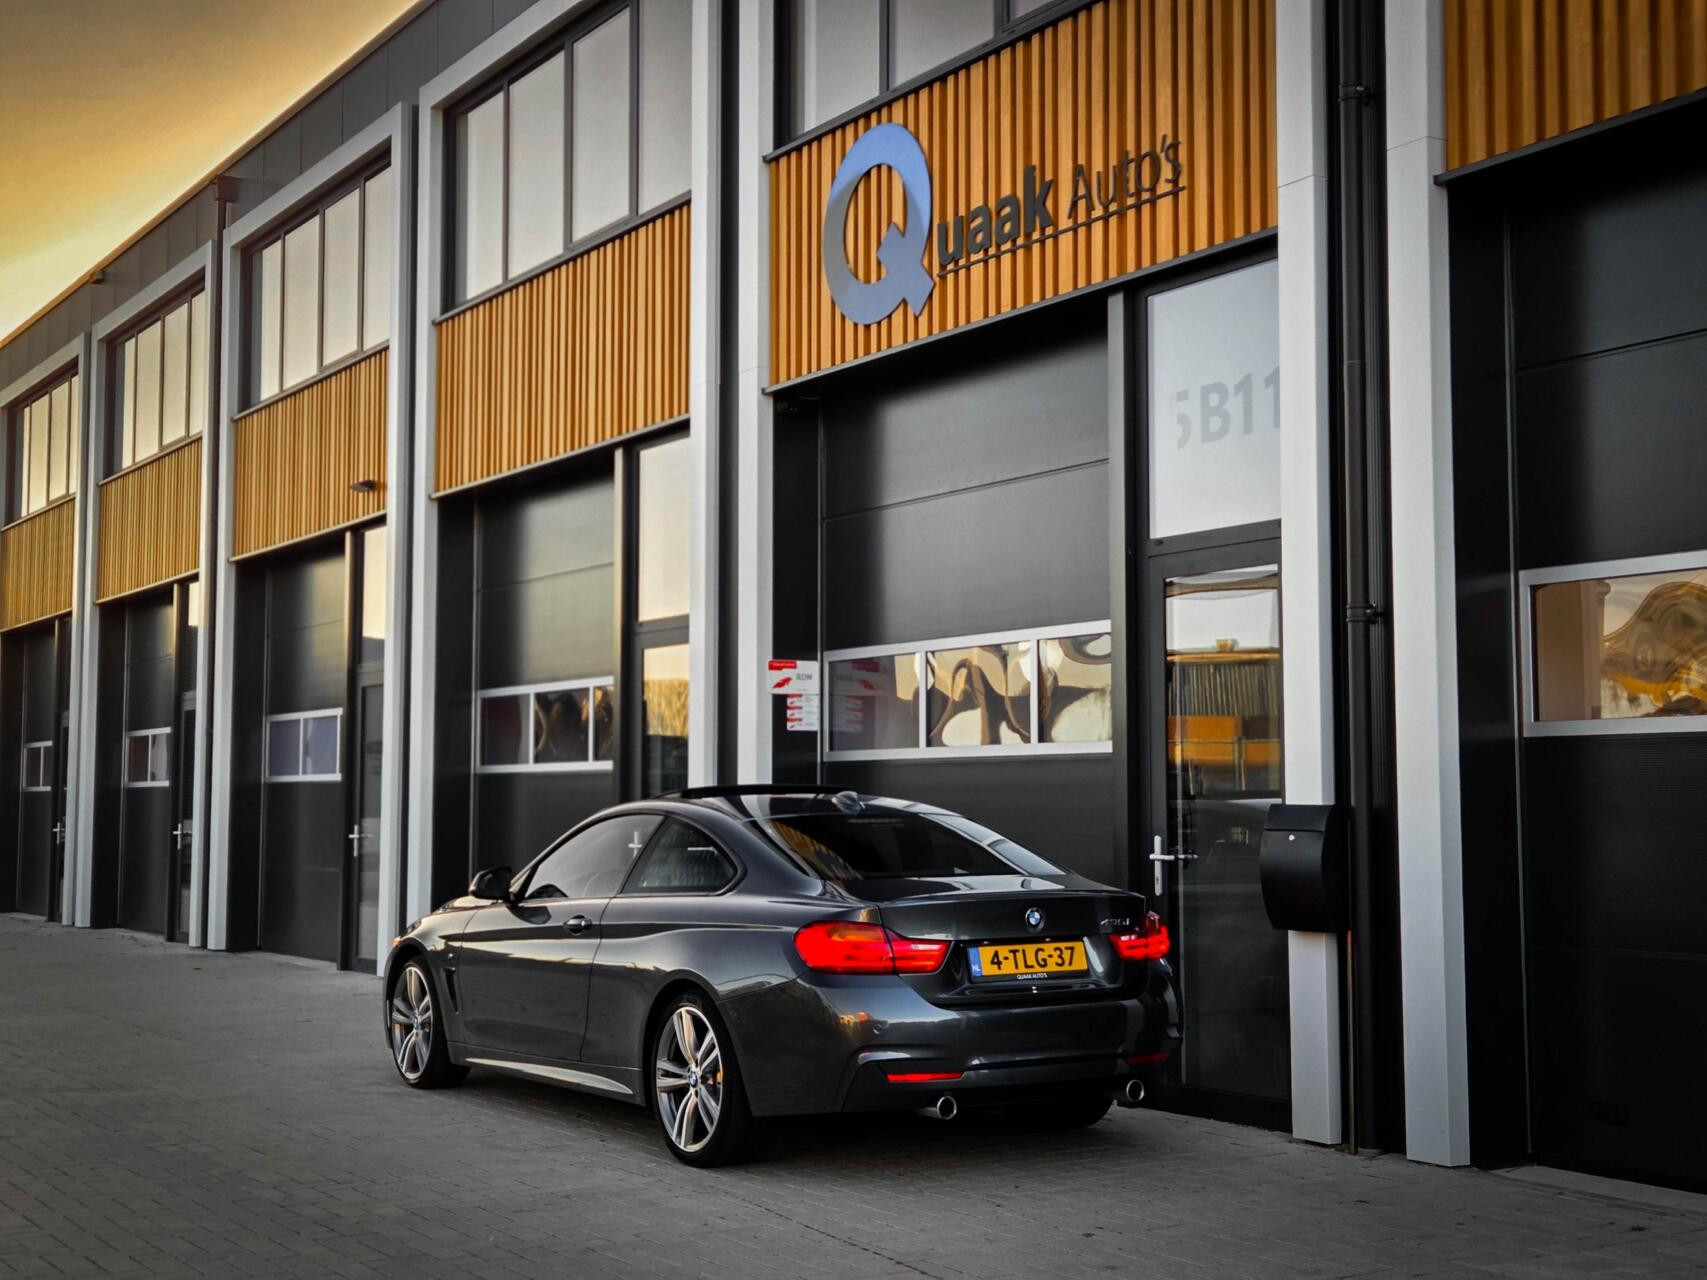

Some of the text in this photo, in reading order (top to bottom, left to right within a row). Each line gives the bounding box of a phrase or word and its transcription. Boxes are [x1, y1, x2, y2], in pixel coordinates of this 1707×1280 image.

[823, 122, 1182, 326] Quaak Auto's
[990, 946, 1075, 970] 4-TLG-37
